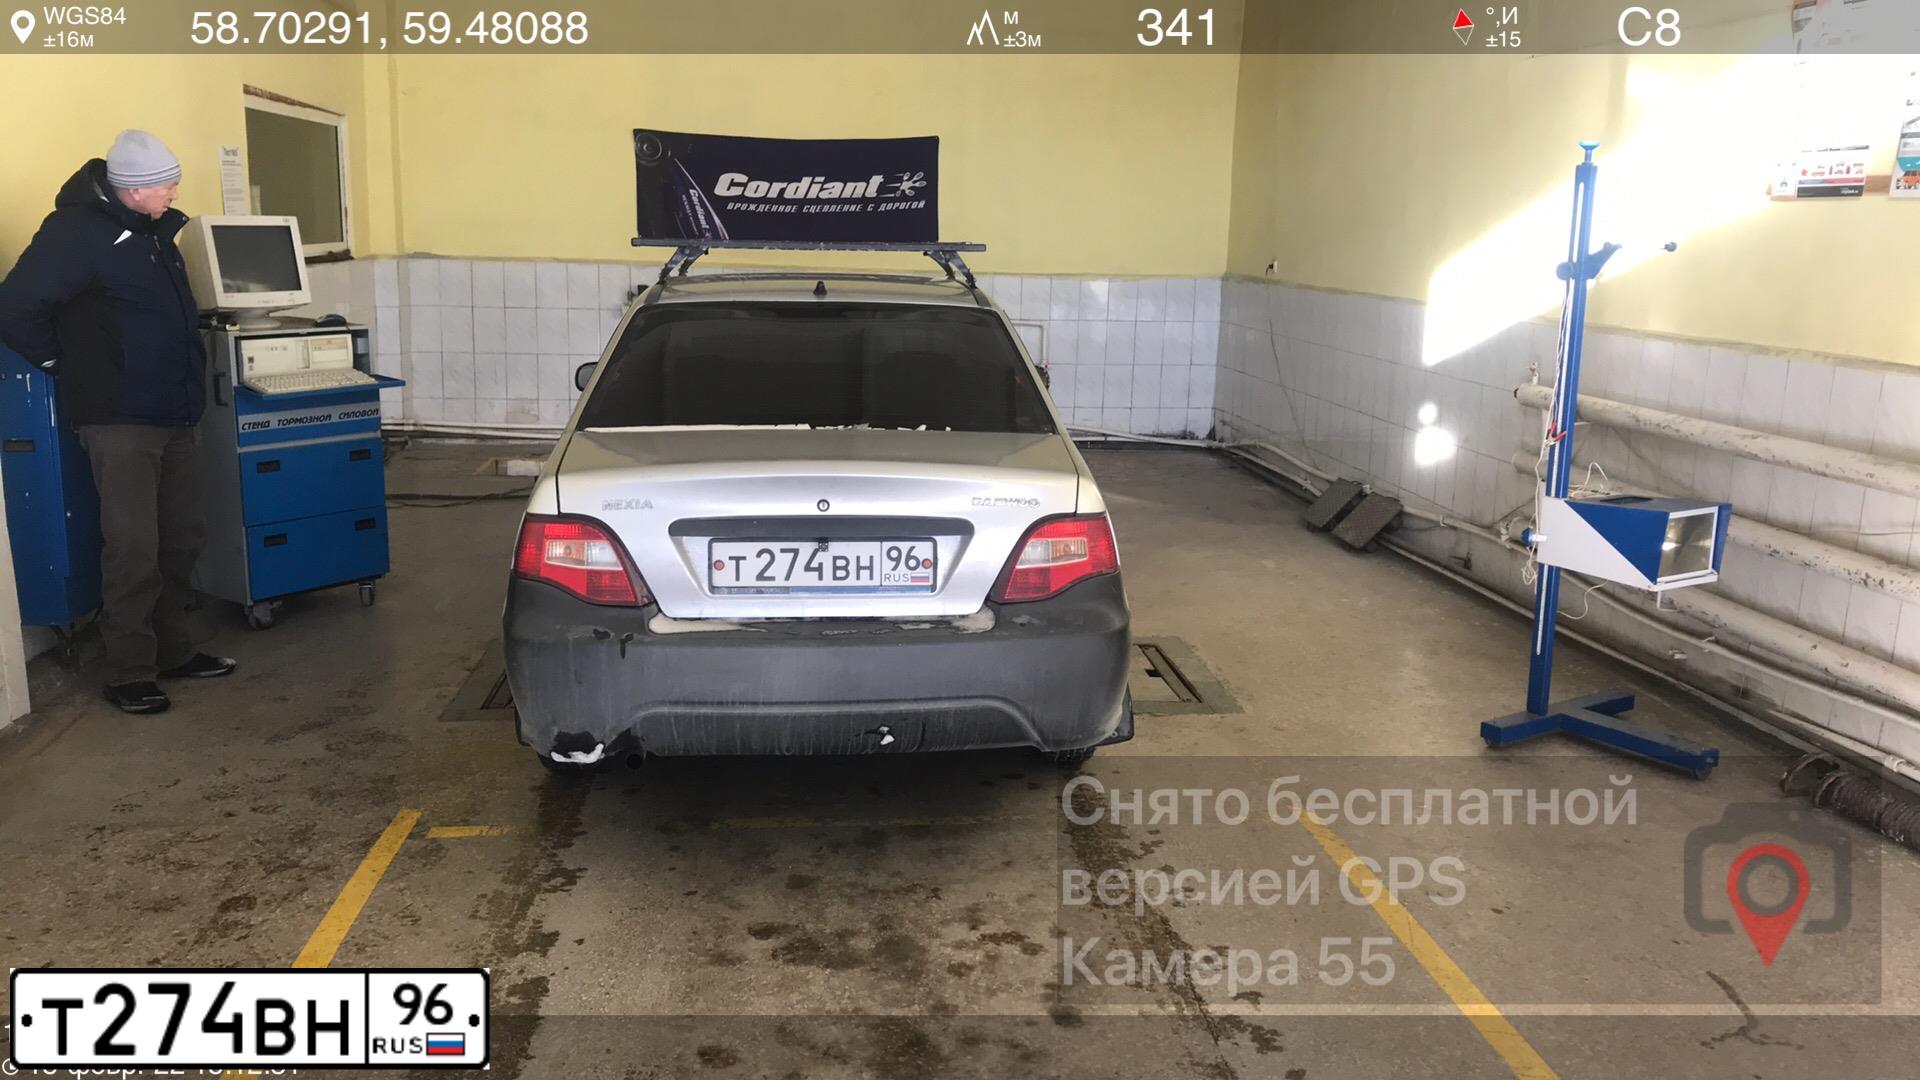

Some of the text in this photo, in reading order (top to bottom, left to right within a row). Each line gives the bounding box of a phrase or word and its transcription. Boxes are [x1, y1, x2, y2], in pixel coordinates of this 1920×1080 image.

[713, 172, 885, 199] Cordiant
[802, 204, 864, 215] СЦЕПЛЕНИЕ
[241, 420, 271, 432] СТЕНД
[601, 498, 654, 511] NEXIA
[886, 545, 921, 572] 96
[883, 573, 910, 583] RUS
